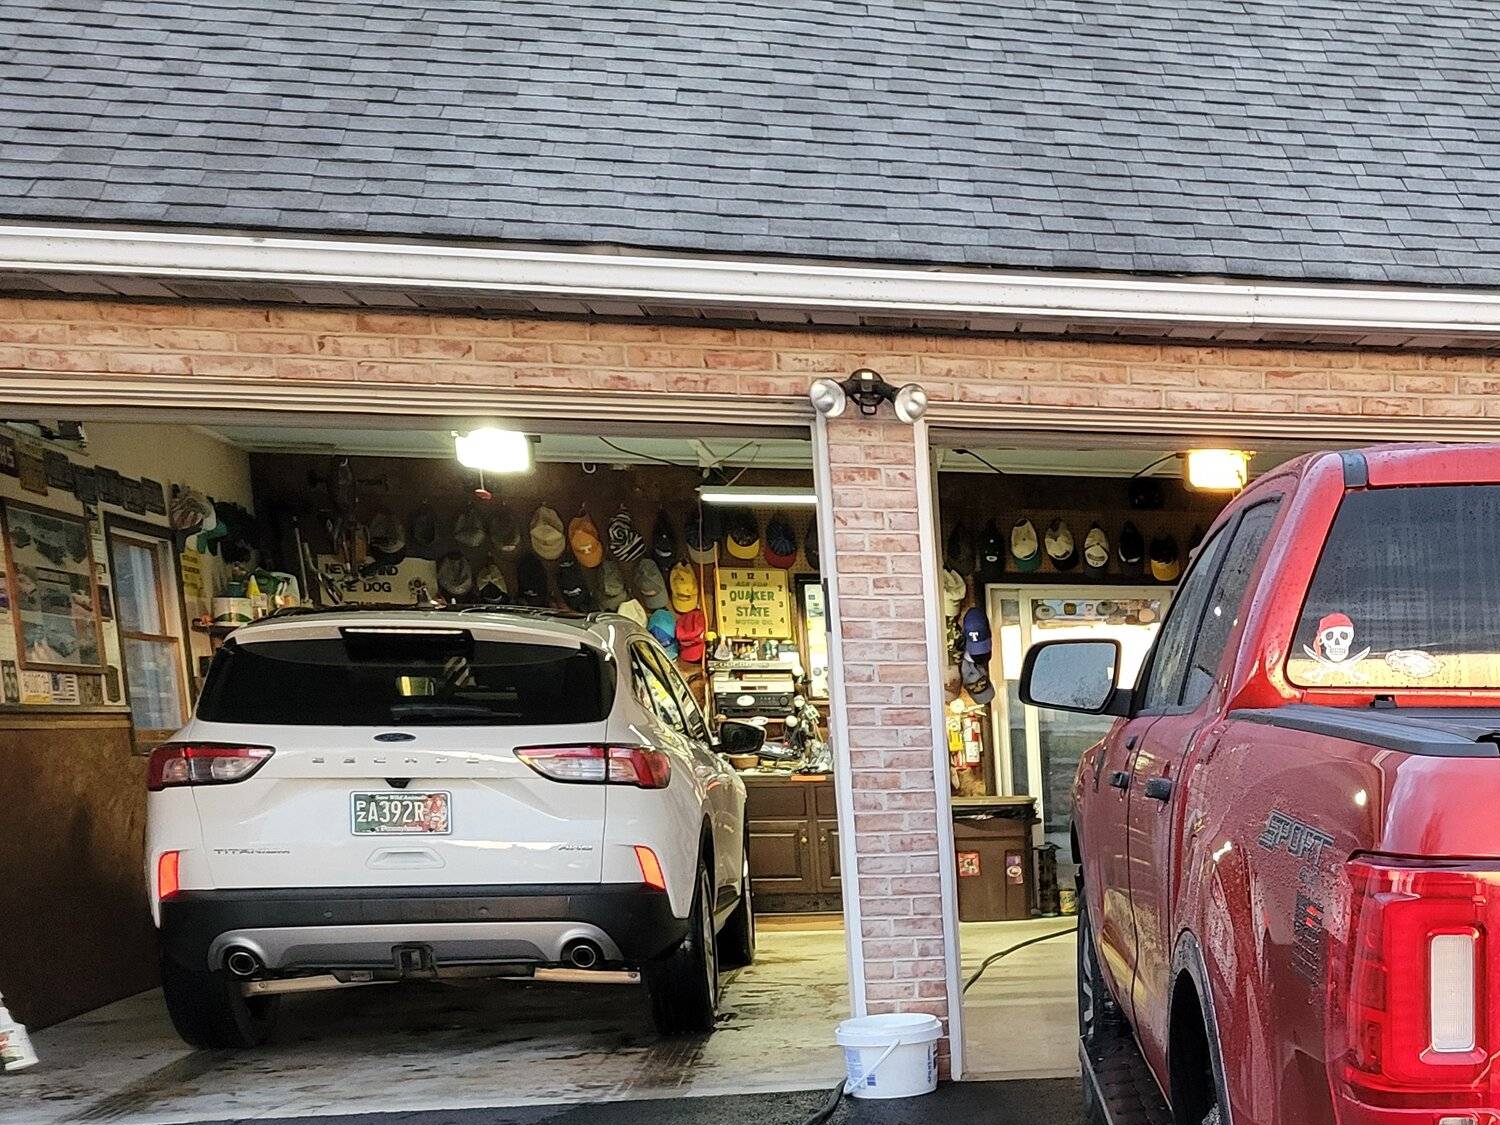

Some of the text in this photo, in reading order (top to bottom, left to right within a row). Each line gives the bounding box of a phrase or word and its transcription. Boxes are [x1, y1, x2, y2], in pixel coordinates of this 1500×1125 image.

[363, 582, 392, 592] DOG
[729, 590, 775, 601] QUAKER
[736, 607, 770, 617] STATE
[368, 801, 425, 822] A392R
